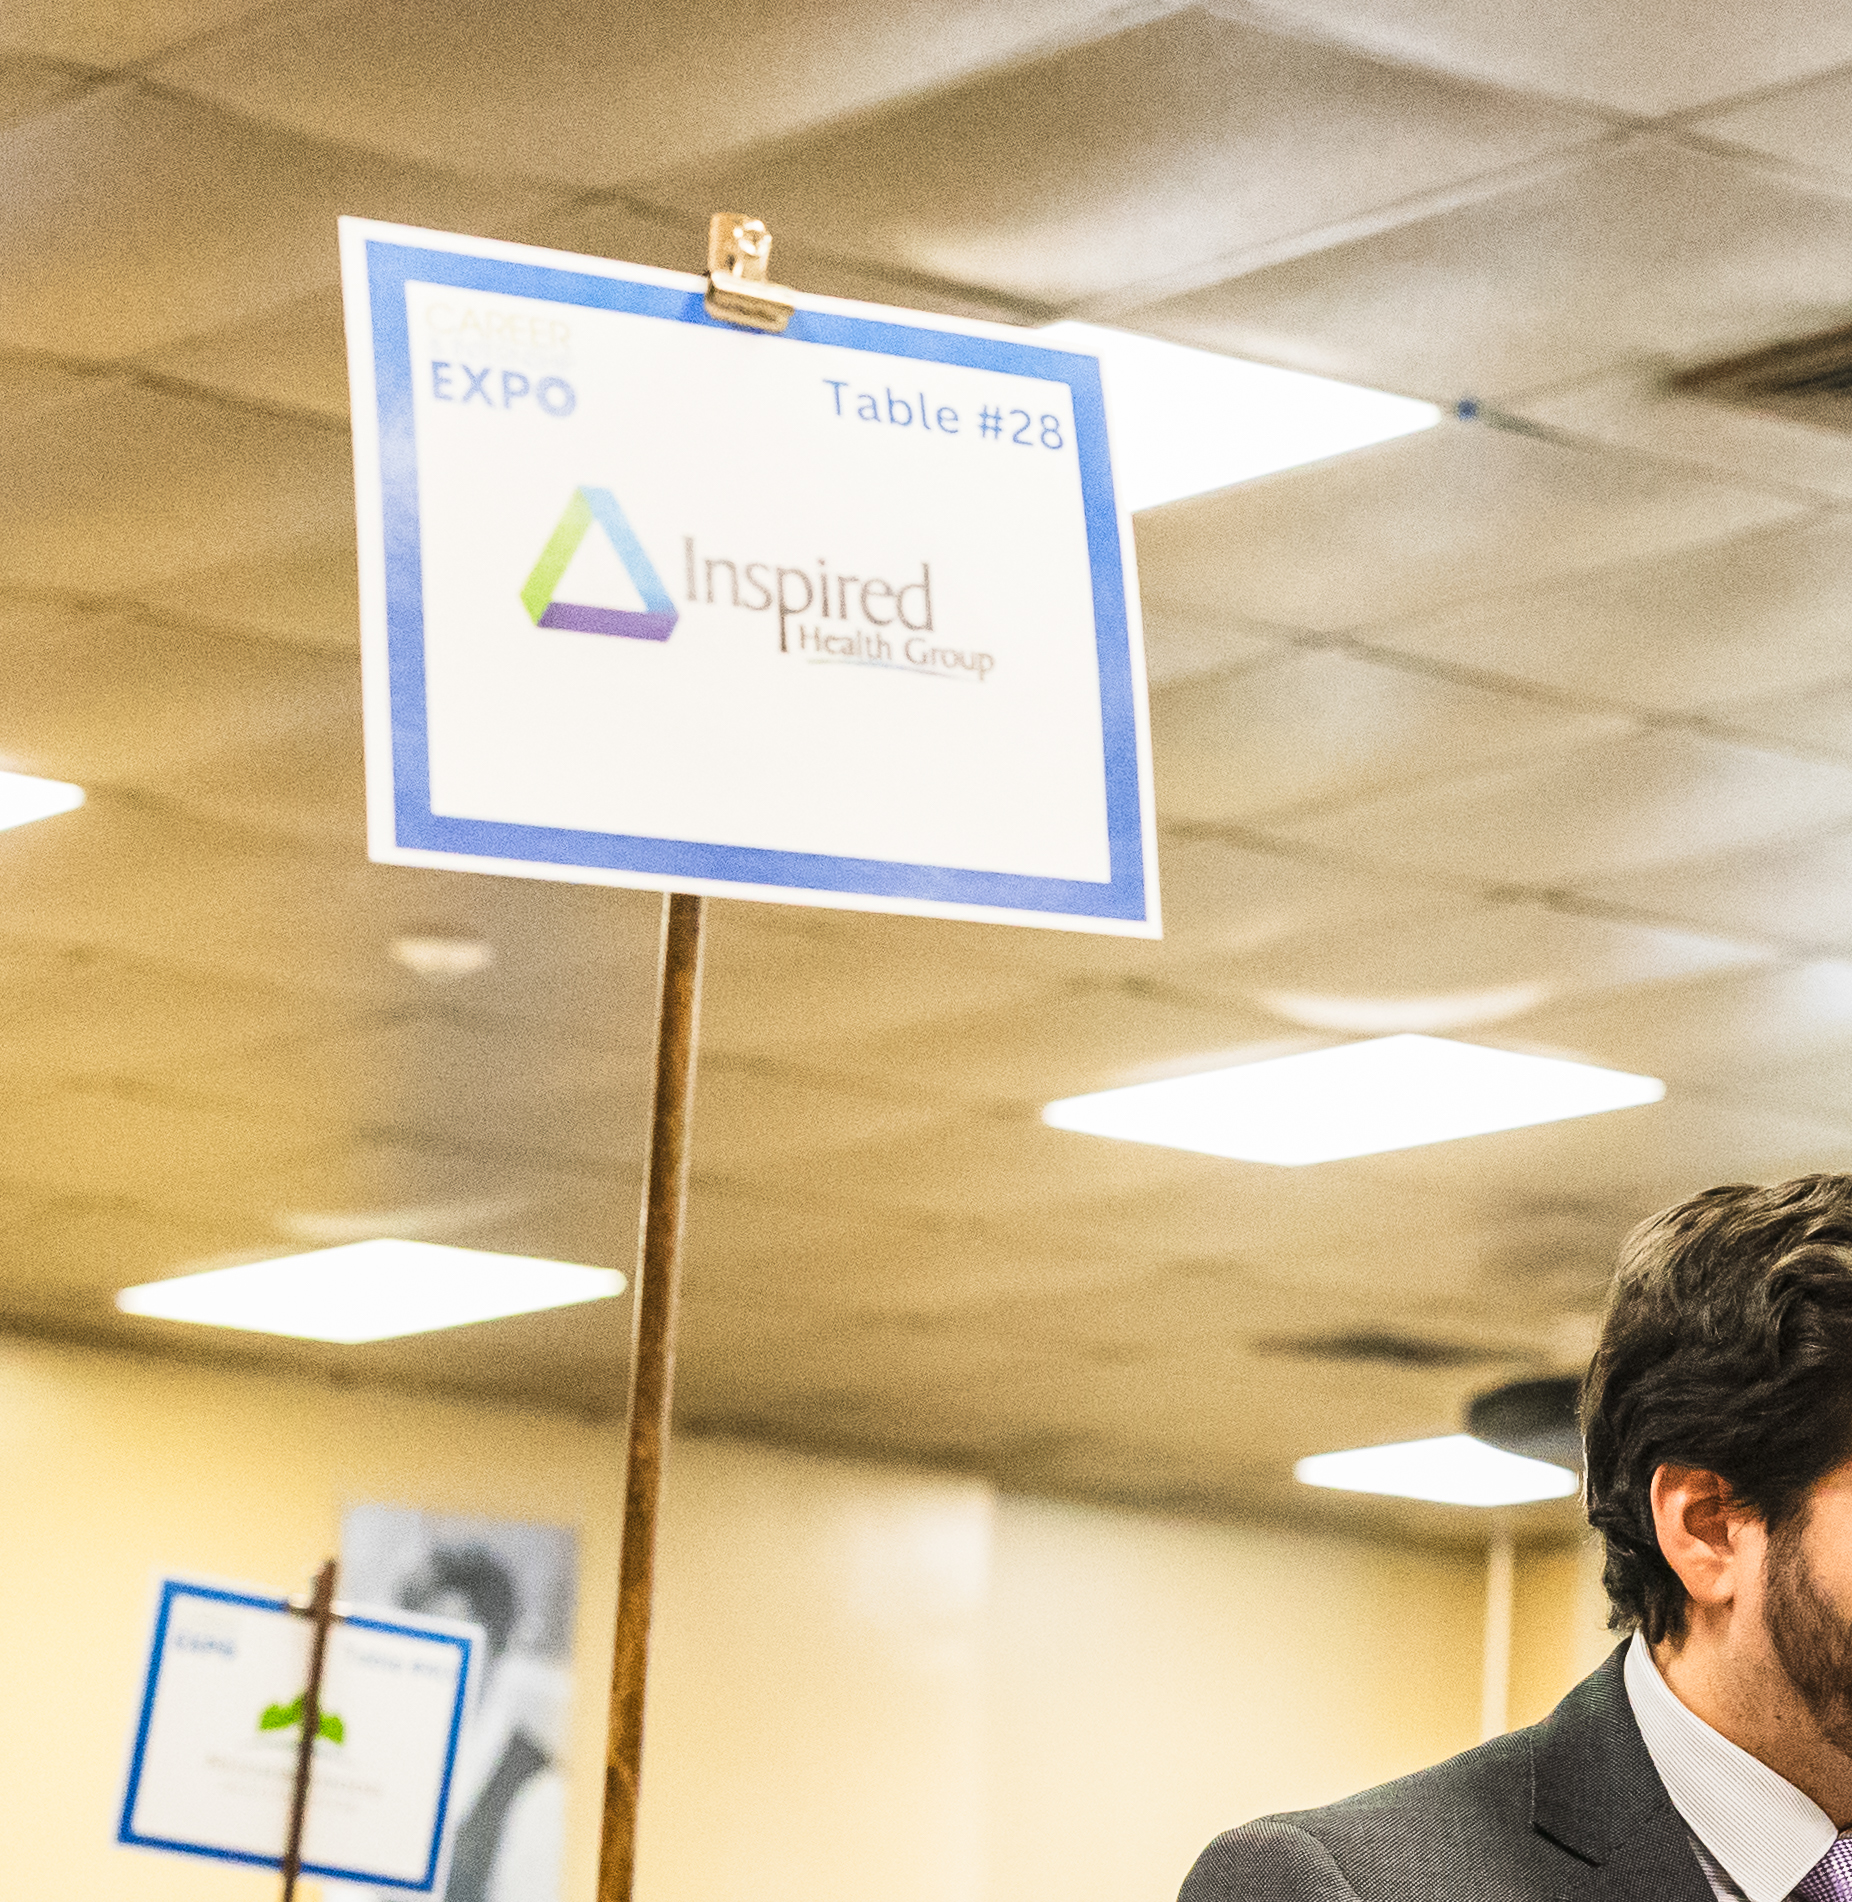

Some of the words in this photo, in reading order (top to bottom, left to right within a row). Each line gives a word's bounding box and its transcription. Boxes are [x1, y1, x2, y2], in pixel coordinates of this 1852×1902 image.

[431, 360, 577, 418] EXPO
[822, 379, 959, 434] Table
[979, 404, 1063, 450] #28
[683, 535, 933, 653] Inspired
[800, 624, 892, 661] Health
[904, 637, 995, 682] Group
